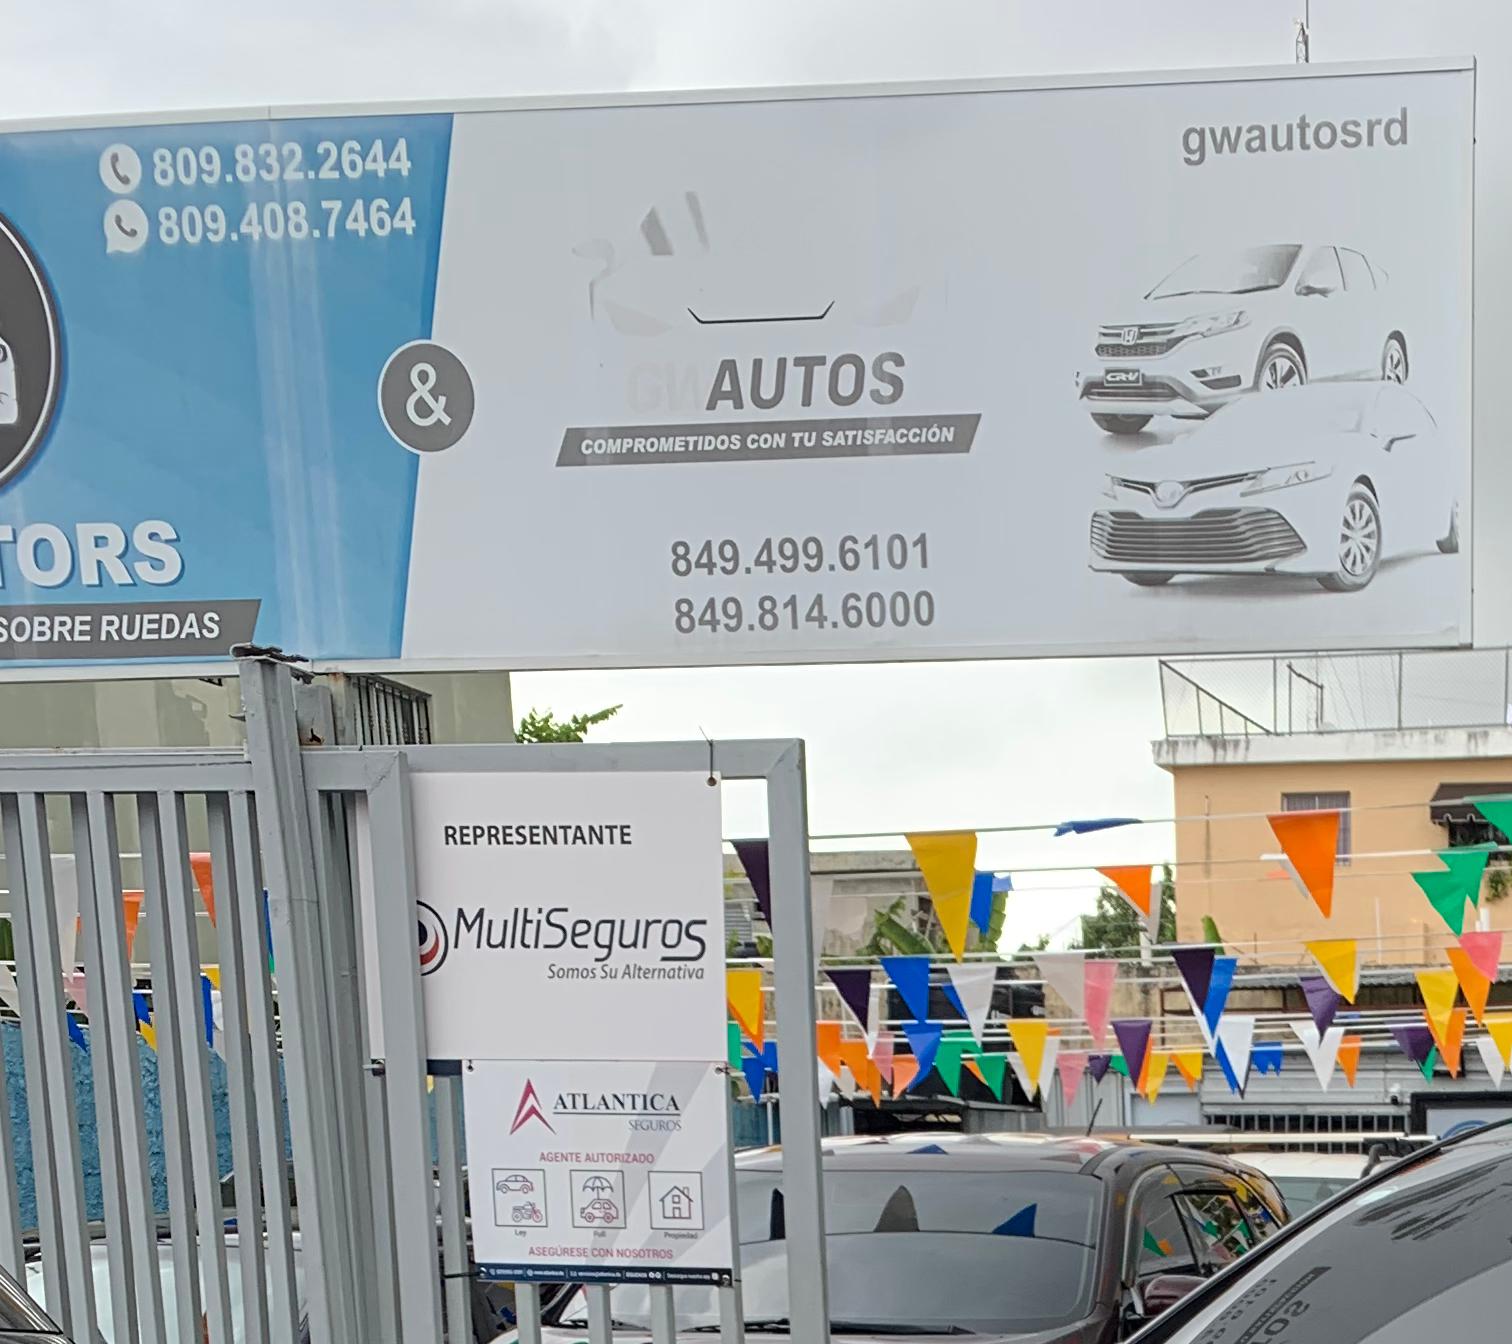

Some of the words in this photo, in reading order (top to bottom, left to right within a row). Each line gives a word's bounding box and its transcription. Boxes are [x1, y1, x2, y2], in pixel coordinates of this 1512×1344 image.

[1181, 107, 1409, 166] gwautosrd
[153, 138, 412, 186] 809.832.2644
[159, 197, 416, 246] 809.408.7464
[406, 361, 452, 427] &
[580, 433, 742, 456] COMPROMETIDOS
[746, 432, 786, 450] CON
[791, 432, 817, 449] TU
[821, 423, 956, 447] SATISFACCIÓN
[671, 532, 931, 577] 849.499.6101
[100, 612, 221, 641] RUEDAS
[673, 589, 935, 634] 849.814.6000
[444, 824, 633, 847] REPRESENTANTE
[453, 906, 709, 963] MultiSeguros
[547, 963, 597, 980] Somos
[599, 963, 619, 980] Su
[621, 963, 705, 981] Alternativa
[552, 1092, 681, 1112] ATLANTICA
[628, 1119, 683, 1132] SEGUROS
[539, 1151, 581, 1163] AGENTE
[584, 1152, 655, 1164] AUTORIZADO
[664, 1231, 699, 1241] Propiedad
[528, 1245, 589, 1258] ASEGÚRESE
[591, 1247, 614, 1259] CON
[616, 1248, 674, 1260] NOSOTROS
